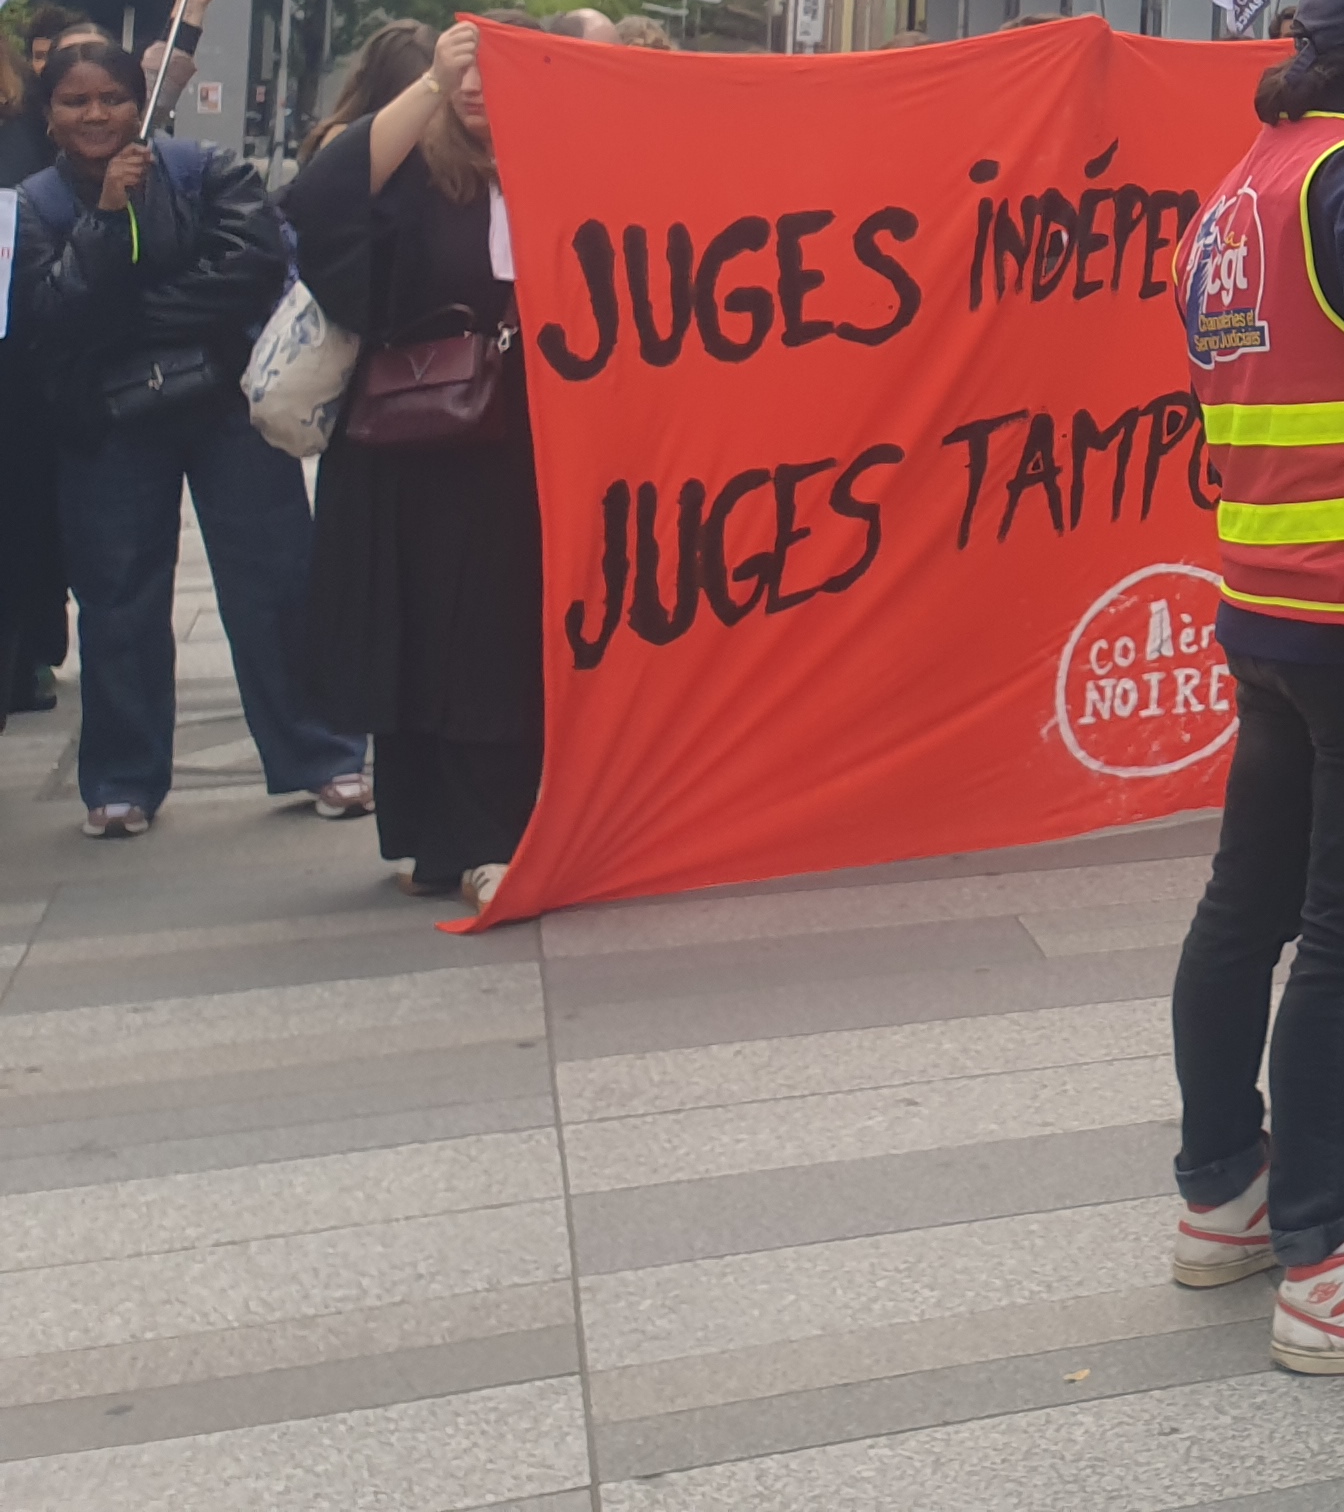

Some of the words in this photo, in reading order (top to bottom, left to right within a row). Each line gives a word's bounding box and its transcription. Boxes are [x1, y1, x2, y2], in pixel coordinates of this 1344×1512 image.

[537, 206, 920, 381] JUGES
[1206, 234, 1248, 306] cgt
[564, 443, 905, 670] JUGES
[1078, 659, 1230, 724] NOIRE
